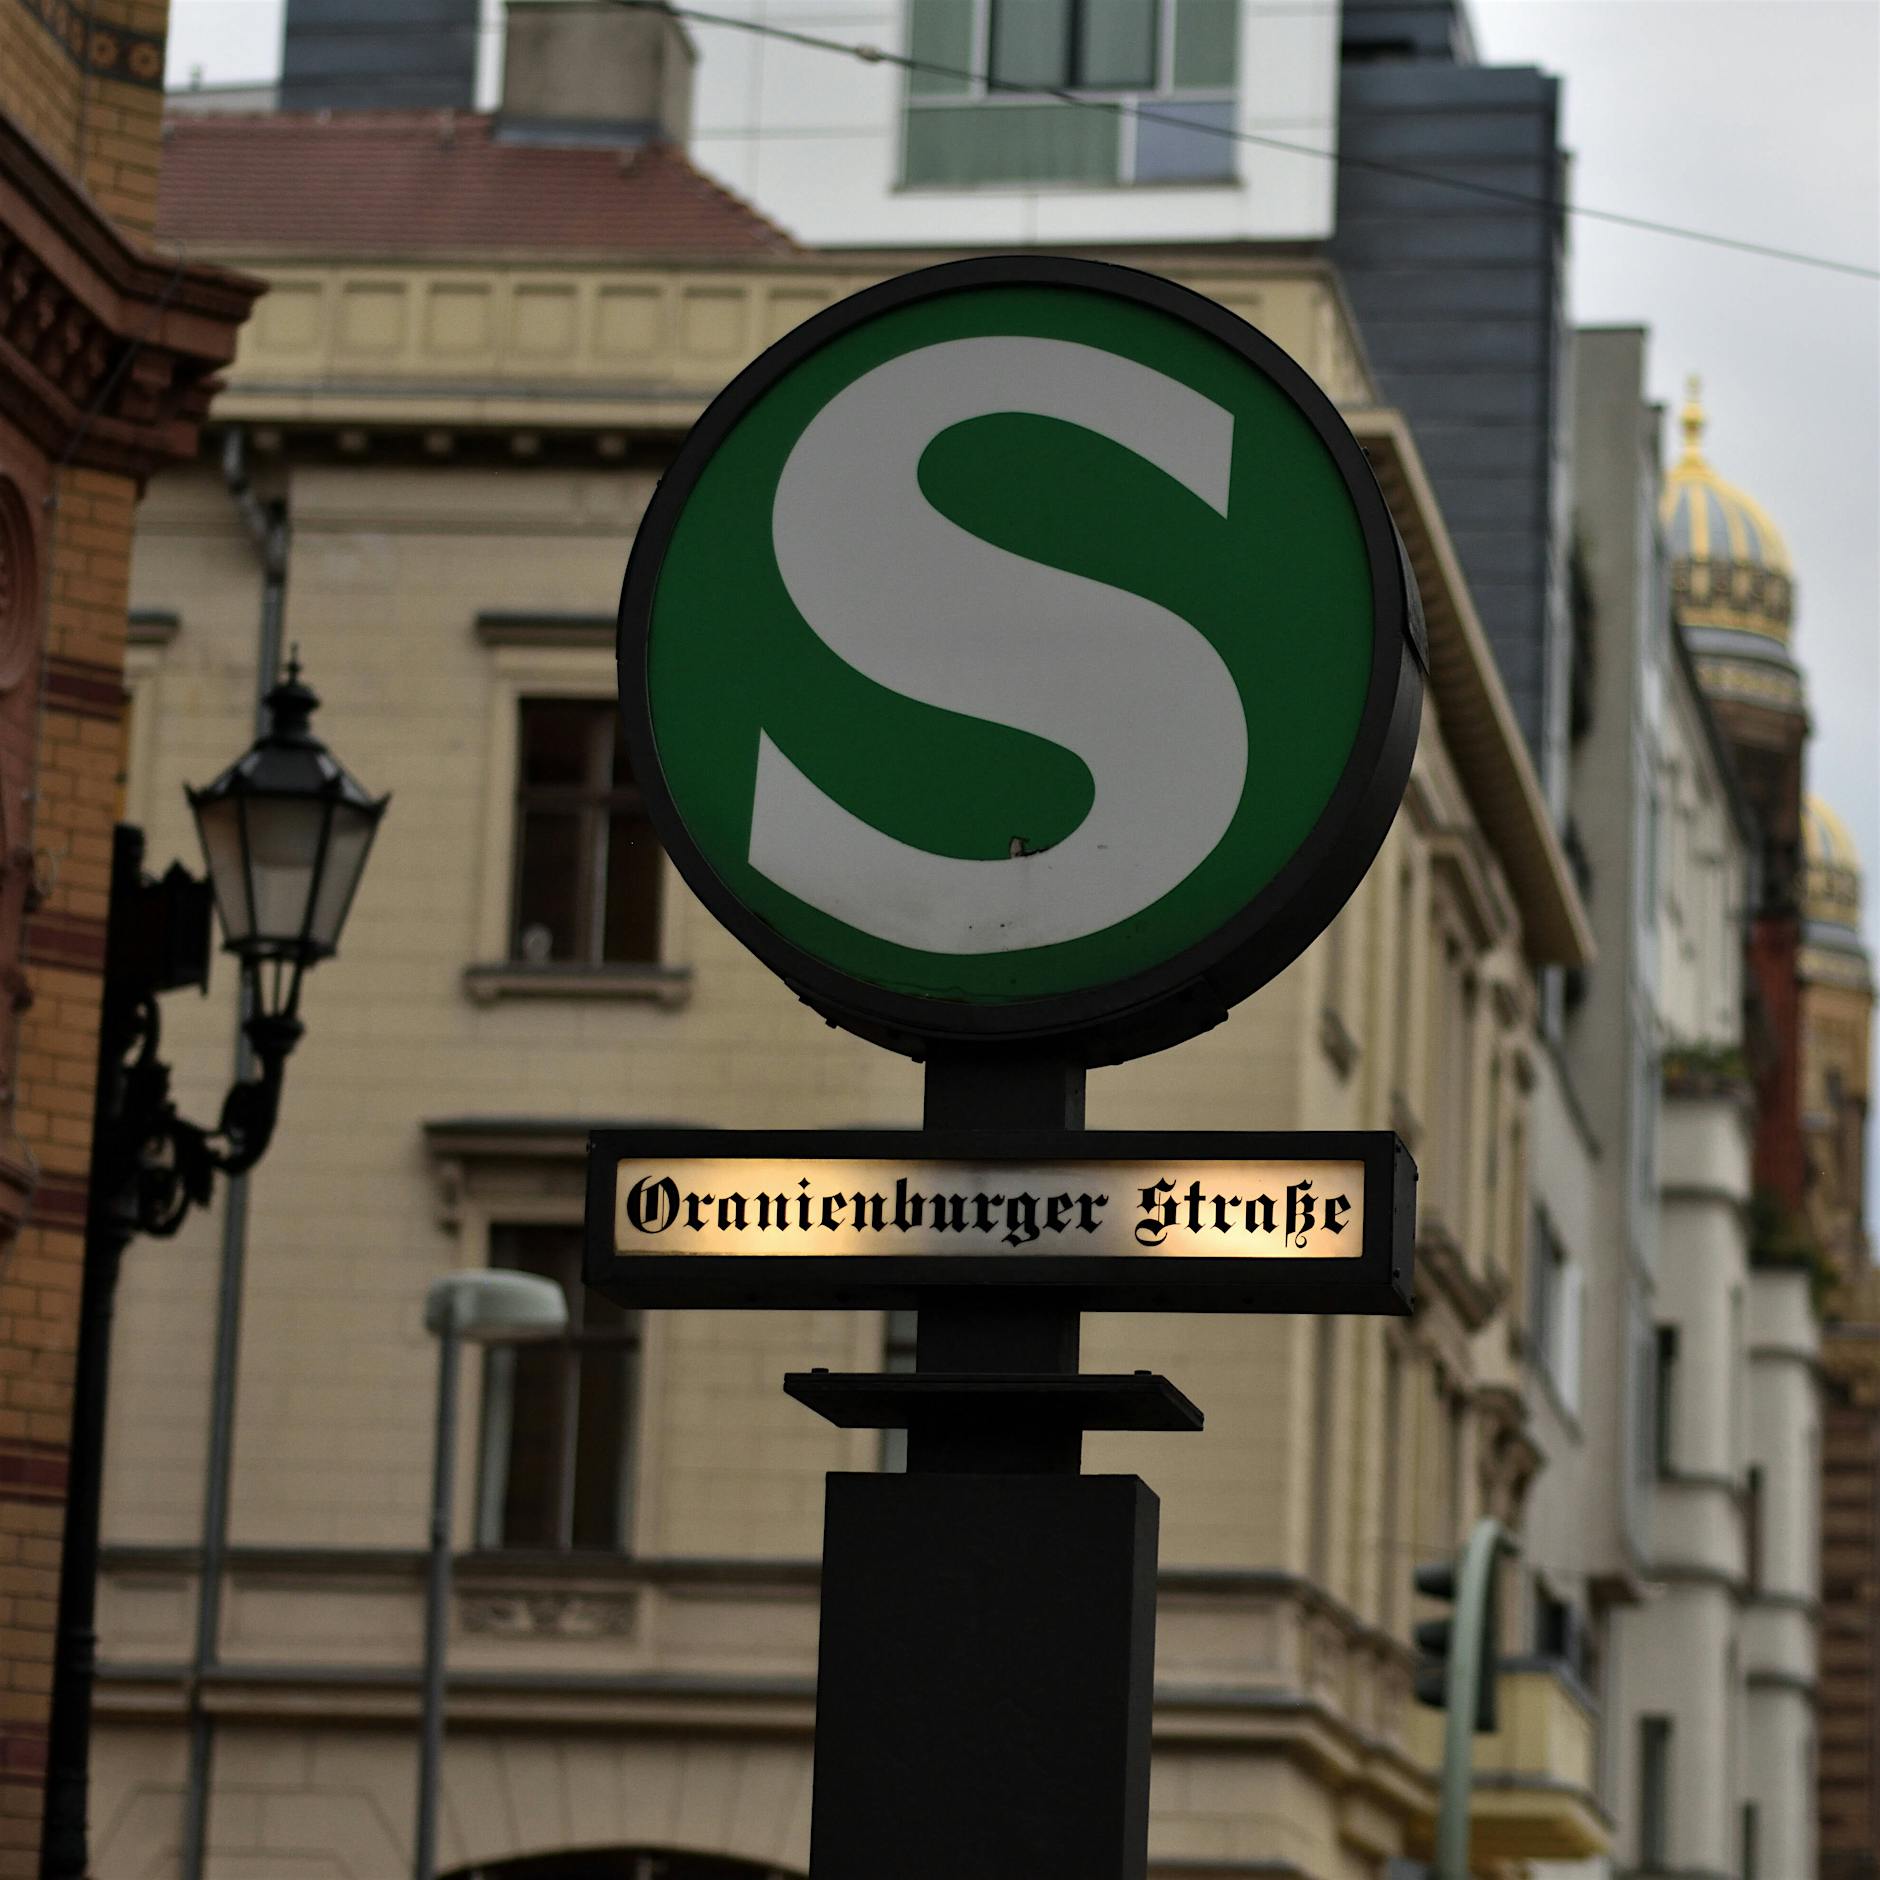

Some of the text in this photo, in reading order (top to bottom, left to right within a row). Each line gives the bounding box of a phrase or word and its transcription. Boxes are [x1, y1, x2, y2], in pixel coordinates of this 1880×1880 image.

[748, 336, 1249, 955] S
[627, 1175, 1352, 1248] Oranienburger Straße
